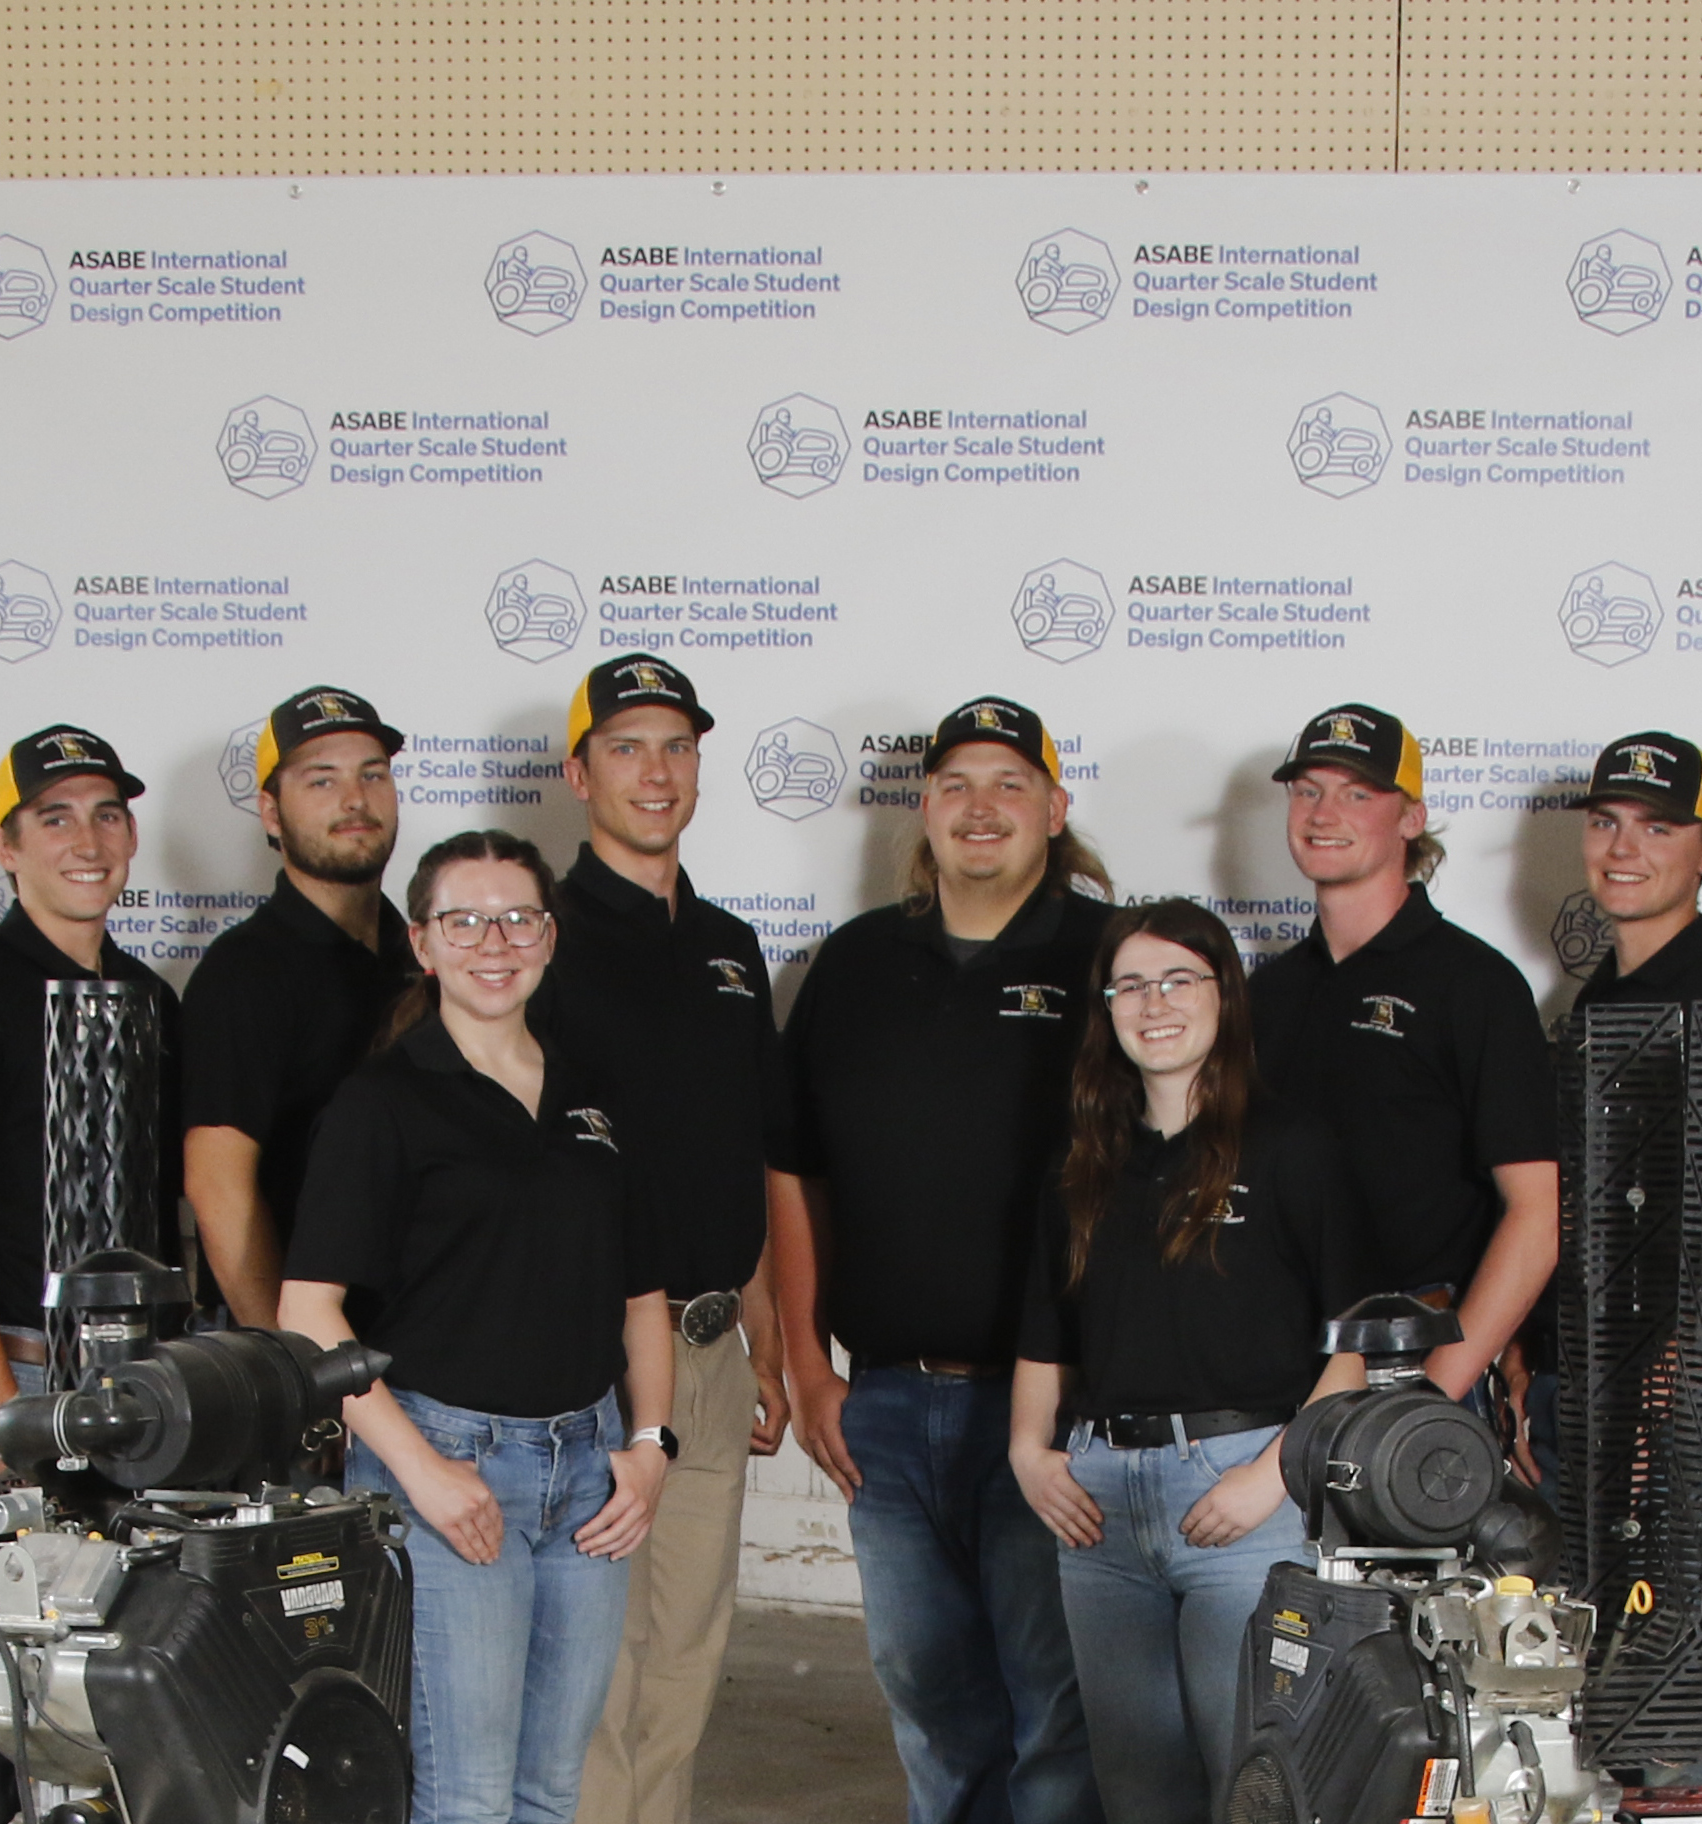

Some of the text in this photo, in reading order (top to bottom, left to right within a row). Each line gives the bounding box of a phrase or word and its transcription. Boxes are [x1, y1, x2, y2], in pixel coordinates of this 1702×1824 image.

[69, 250, 287, 270] ASABE International
[600, 246, 822, 266] ASABE International
[1134, 244, 1359, 264] ASABE International
[70, 276, 305, 297] Quarter Scale Student
[600, 272, 840, 294] Quarter Scale Student
[1134, 271, 1377, 292] Quarter Scale Student
[71, 303, 280, 326] Design Competition
[601, 299, 815, 323] Design Competition
[1134, 298, 1351, 321] Design Competition
[330, 411, 548, 431] ASABE International
[863, 410, 1086, 429] ASABE International
[1406, 409, 1632, 429] ASABE International
[330, 437, 566, 459] Quarter Scale Student
[864, 436, 1104, 457] Quarter Scale Student
[1405, 437, 1649, 458] Quarter Scale Student
[331, 463, 542, 487] Design Competition
[864, 463, 1079, 486] Design Competition
[1406, 463, 1624, 486] Design Competition
[74, 576, 288, 595] ASABE International
[600, 575, 819, 595] ASABE International
[1128, 575, 1352, 595] ASABE International
[75, 602, 306, 623] Quarter Scale Student
[600, 602, 837, 623] Quarter Scale Student
[1128, 602, 1370, 623] Quarter Scale Student
[75, 628, 282, 650] Design Competition
[600, 628, 812, 651] Design Competition
[1128, 628, 1344, 651] Design Competition
[412, 735, 548, 754] International
[1419, 738, 1478, 756] SABE
[418, 760, 477, 779] Scale
[482, 760, 565, 779] Student
[1490, 765, 1548, 783] Scale
[409, 786, 541, 808] Competition
[860, 788, 920, 809] Desig
[161, 916, 216, 933] Scale
[750, 920, 832, 938] Student
[280, 1580, 344, 1611] VANGUARD
